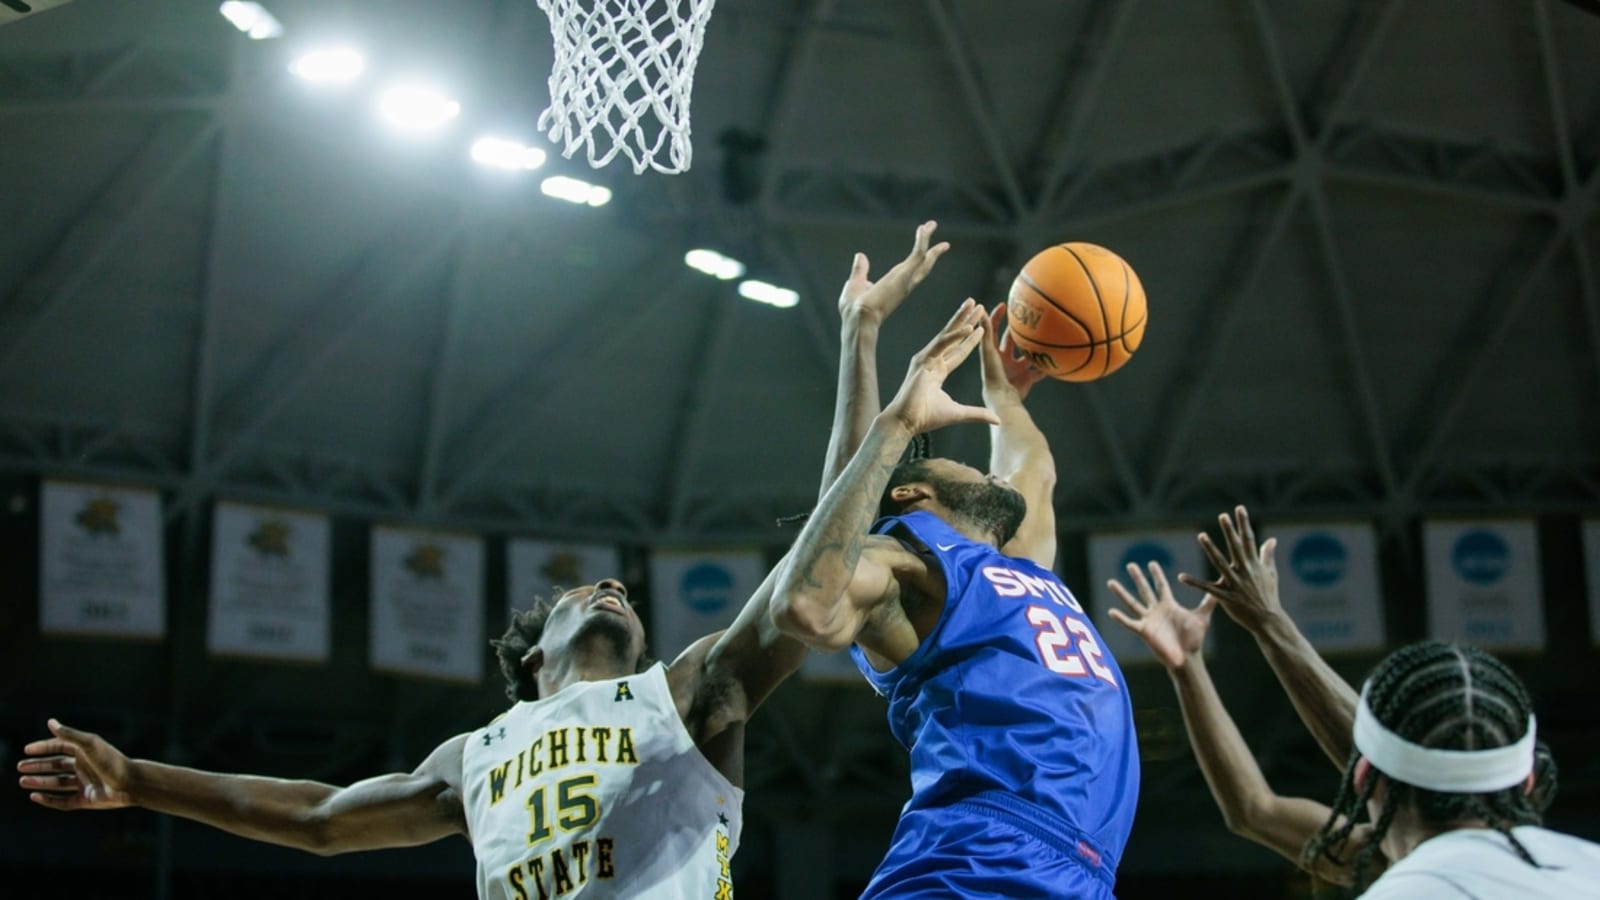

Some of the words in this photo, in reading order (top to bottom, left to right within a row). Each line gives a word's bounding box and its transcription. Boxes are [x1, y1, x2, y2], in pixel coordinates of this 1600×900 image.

[981, 566, 1084, 614] SMU
[1025, 604, 1119, 691] 22
[488, 726, 639, 806] WICHITA
[524, 773, 602, 848] 15
[508, 837, 615, 900] STATE
